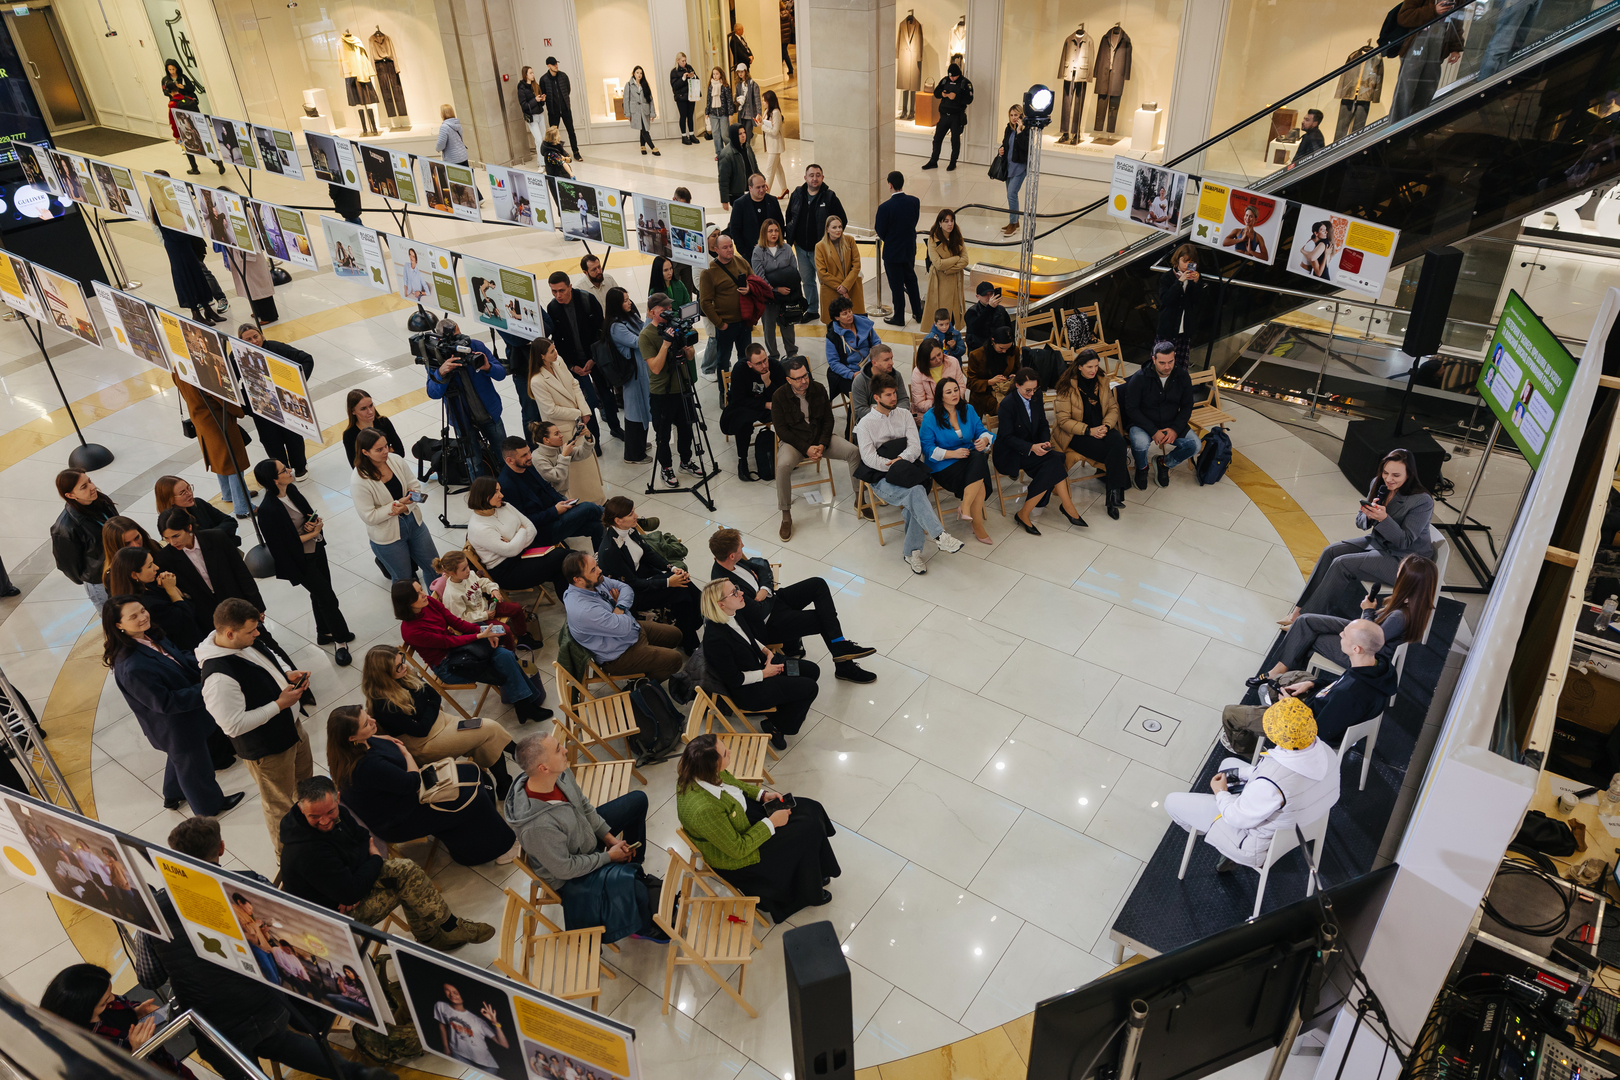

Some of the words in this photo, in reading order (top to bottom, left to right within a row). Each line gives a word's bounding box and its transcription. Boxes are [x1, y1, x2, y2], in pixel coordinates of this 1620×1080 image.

[18, 194, 46, 205] GULLIVER
[162, 863, 188, 879] ALOHA
[1482, 1010, 1495, 1032] YAMAHA
